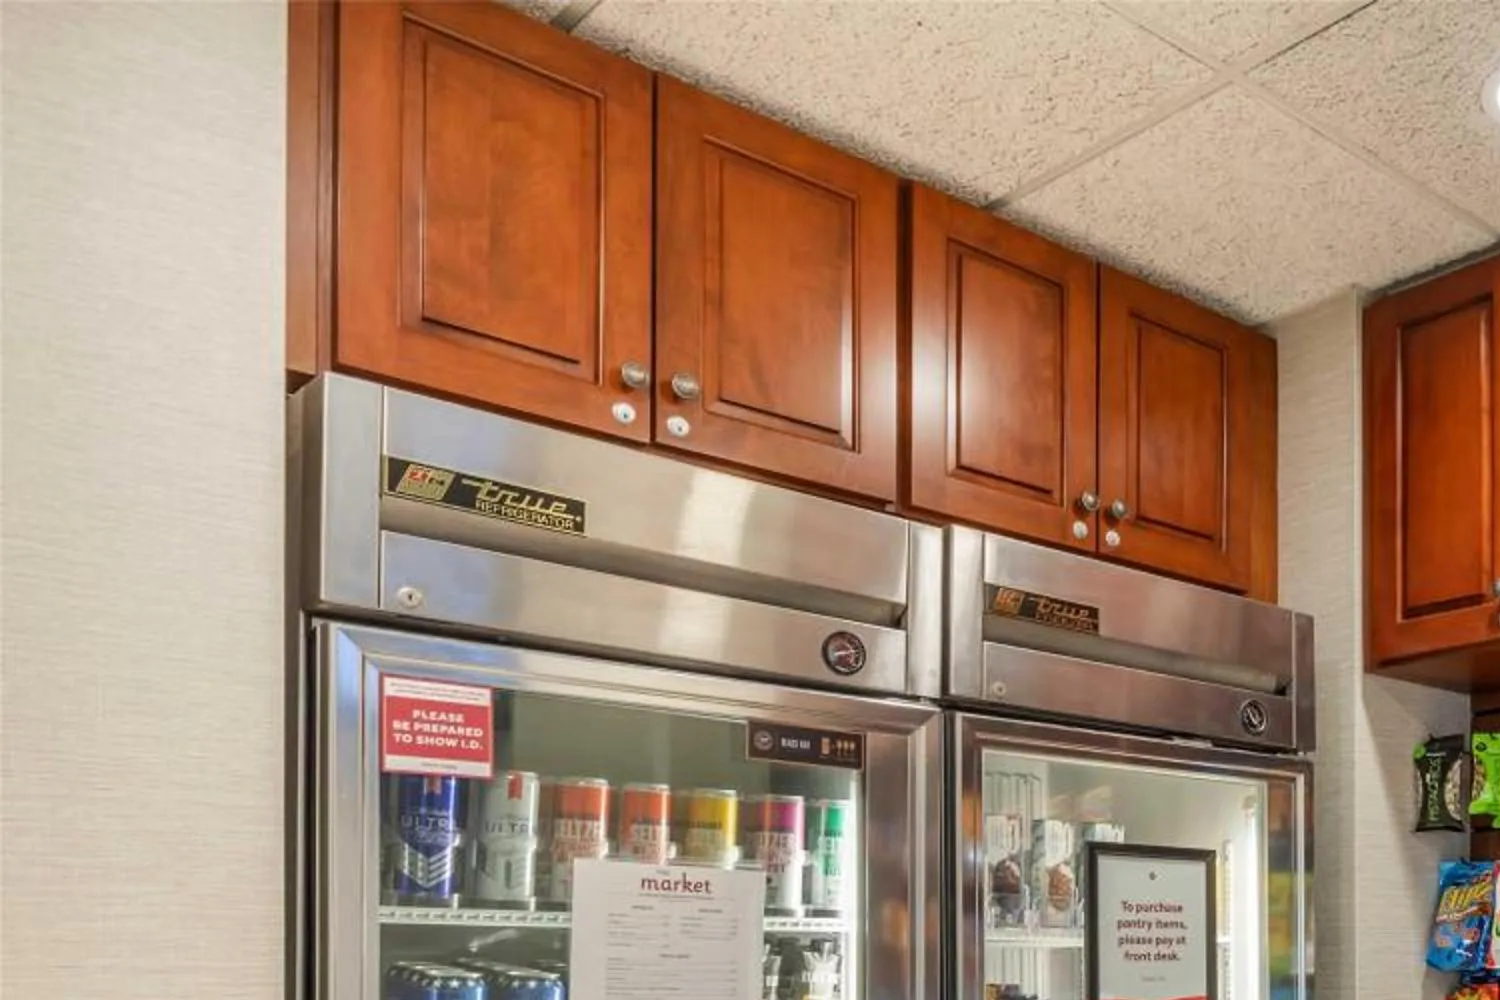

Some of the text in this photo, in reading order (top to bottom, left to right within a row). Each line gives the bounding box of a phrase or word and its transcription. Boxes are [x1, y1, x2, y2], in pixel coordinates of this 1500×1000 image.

[461, 477, 576, 519] true
[475, 500, 575, 530] REFRIGERATOR
[412, 708, 465, 724] PLEASE
[393, 719, 484, 738] BE PREPARED
[393, 732, 484, 752] TO SHOW I.D.
[641, 872, 713, 895] market
[1121, 901, 1183, 915] To purchase
[1117, 918, 1152, 931] pantry
[1118, 934, 1153, 948] please
[1155, 936, 1173, 948] pay
[1124, 950, 1152, 962] front
